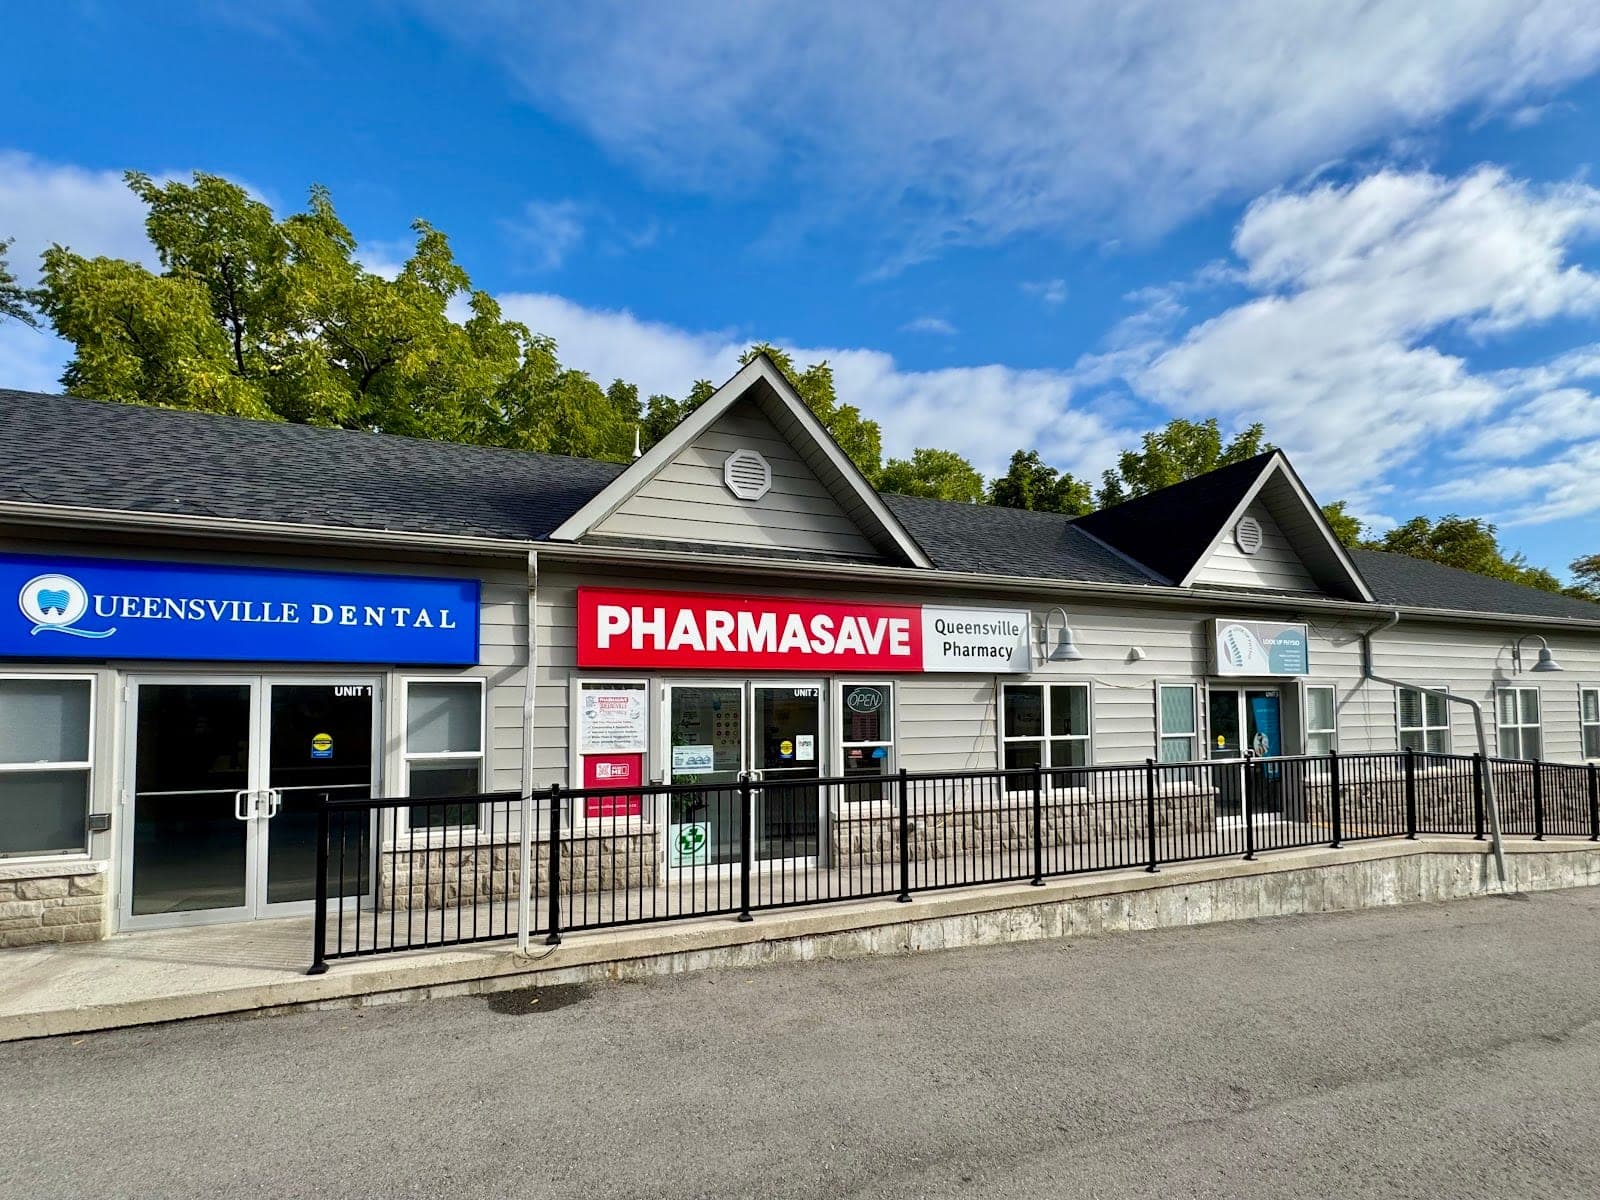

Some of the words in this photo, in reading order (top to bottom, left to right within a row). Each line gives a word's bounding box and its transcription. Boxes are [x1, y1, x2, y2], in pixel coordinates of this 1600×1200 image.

[311, 604, 456, 629] DENTAL
[597, 604, 911, 656] PHARMASAVE
[935, 618, 1019, 636] Queensville
[943, 641, 1013, 661] Pharmacy
[334, 686, 363, 696] UNIT
[366, 686, 372, 696] 1
[794, 688, 812, 697] UNIT
[813, 688, 819, 697] 2
[850, 693, 880, 706] OPEN
